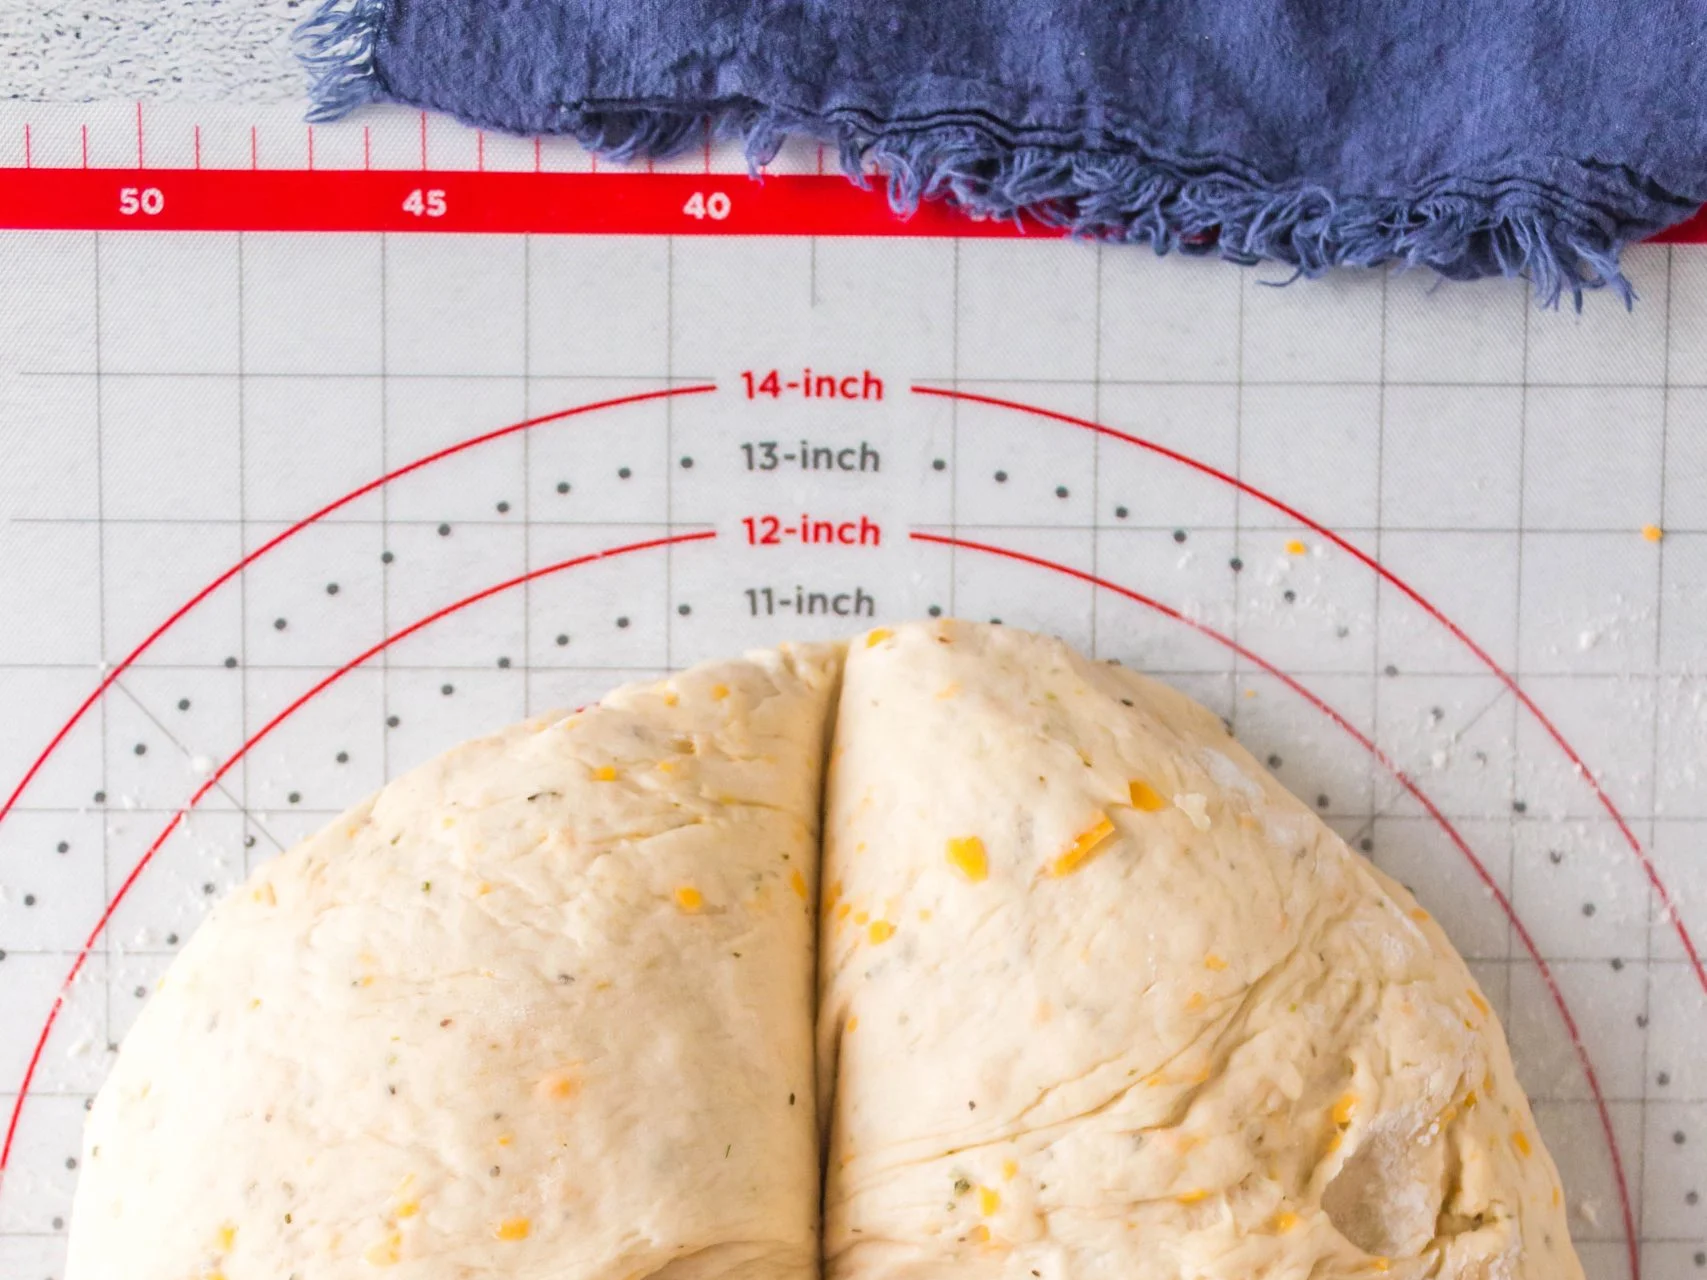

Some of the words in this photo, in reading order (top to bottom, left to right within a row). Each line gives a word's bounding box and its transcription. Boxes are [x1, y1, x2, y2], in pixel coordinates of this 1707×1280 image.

[120, 188, 164, 215] 50
[403, 189, 446, 217] 45
[683, 192, 731, 220] 40
[741, 369, 884, 399] 14-inch
[741, 441, 880, 472] 13-inch
[742, 514, 881, 545] 12-inch
[746, 586, 875, 617] 11-inch
